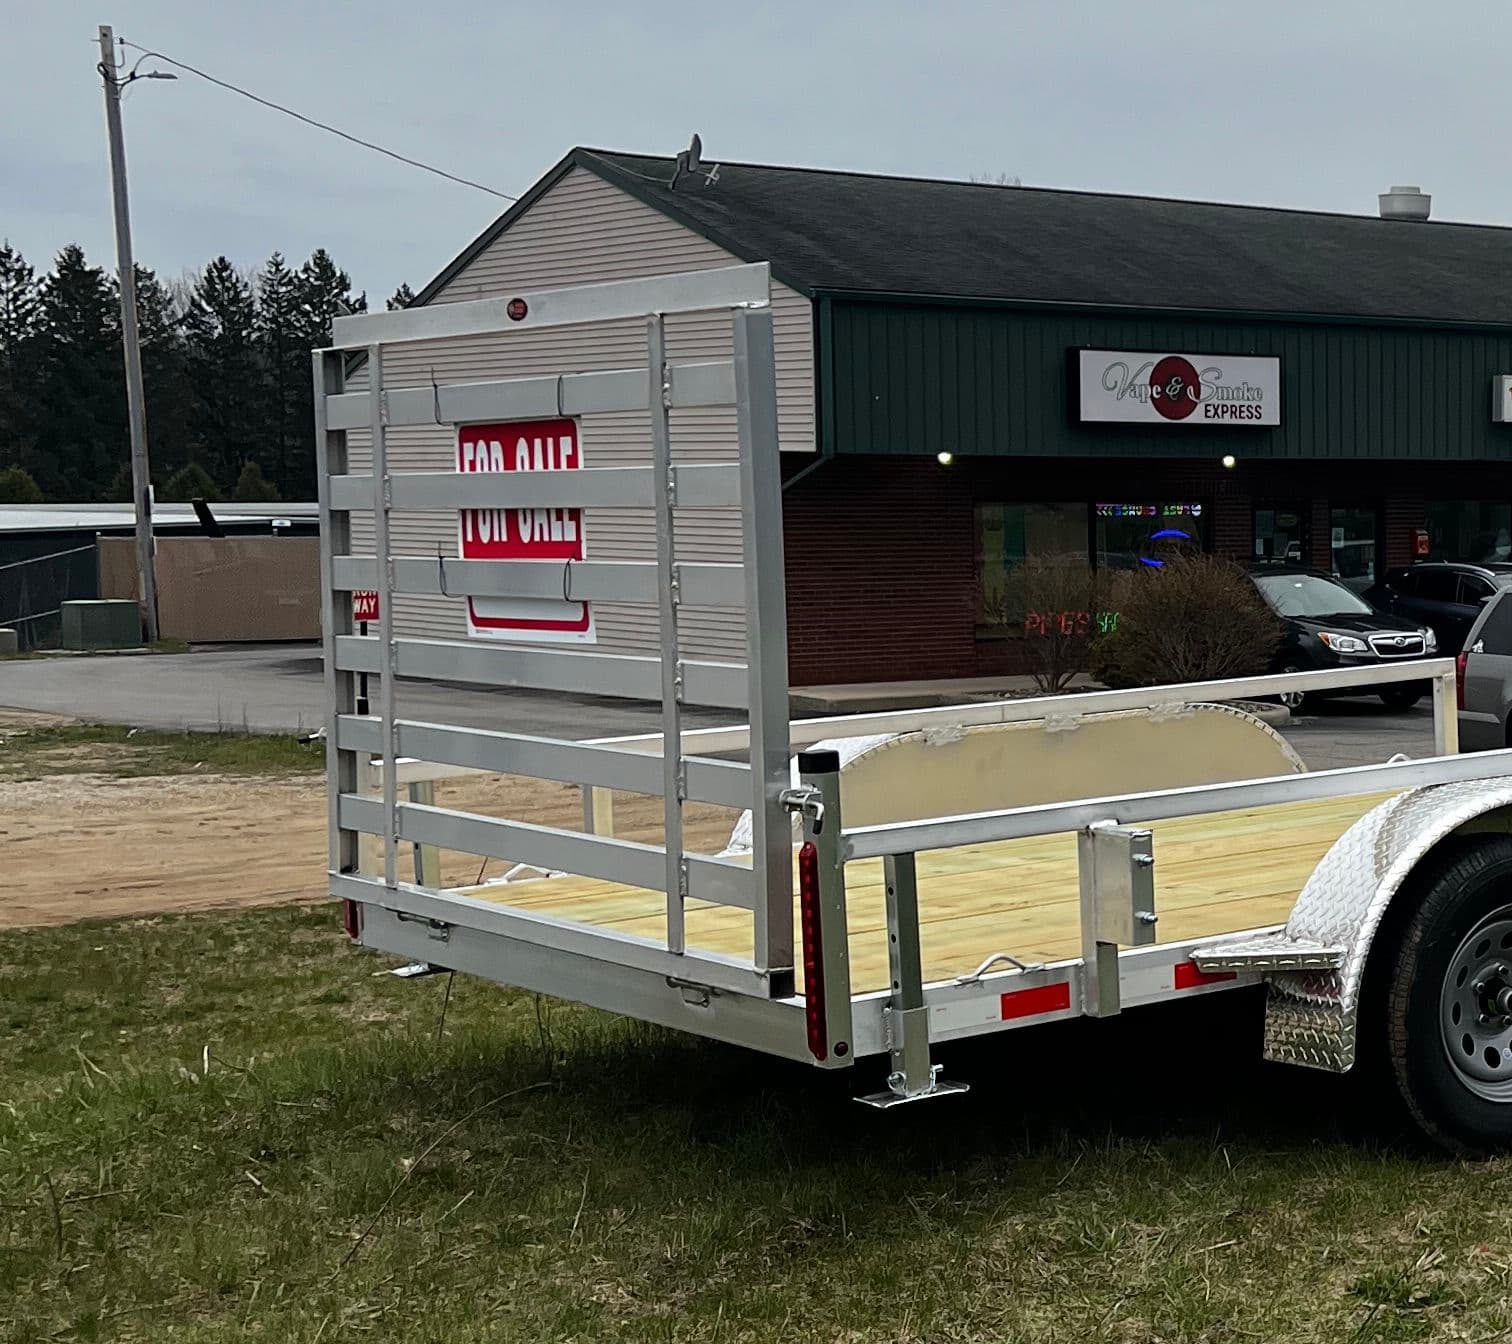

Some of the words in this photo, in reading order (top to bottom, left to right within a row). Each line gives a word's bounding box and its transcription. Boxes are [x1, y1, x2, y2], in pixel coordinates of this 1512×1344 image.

[1102, 361, 1162, 403] Vape
[1166, 377, 1184, 398] &
[1187, 367, 1263, 403] Smoke
[1204, 404, 1262, 420] EXPRESS
[353, 598, 376, 613] WAY
